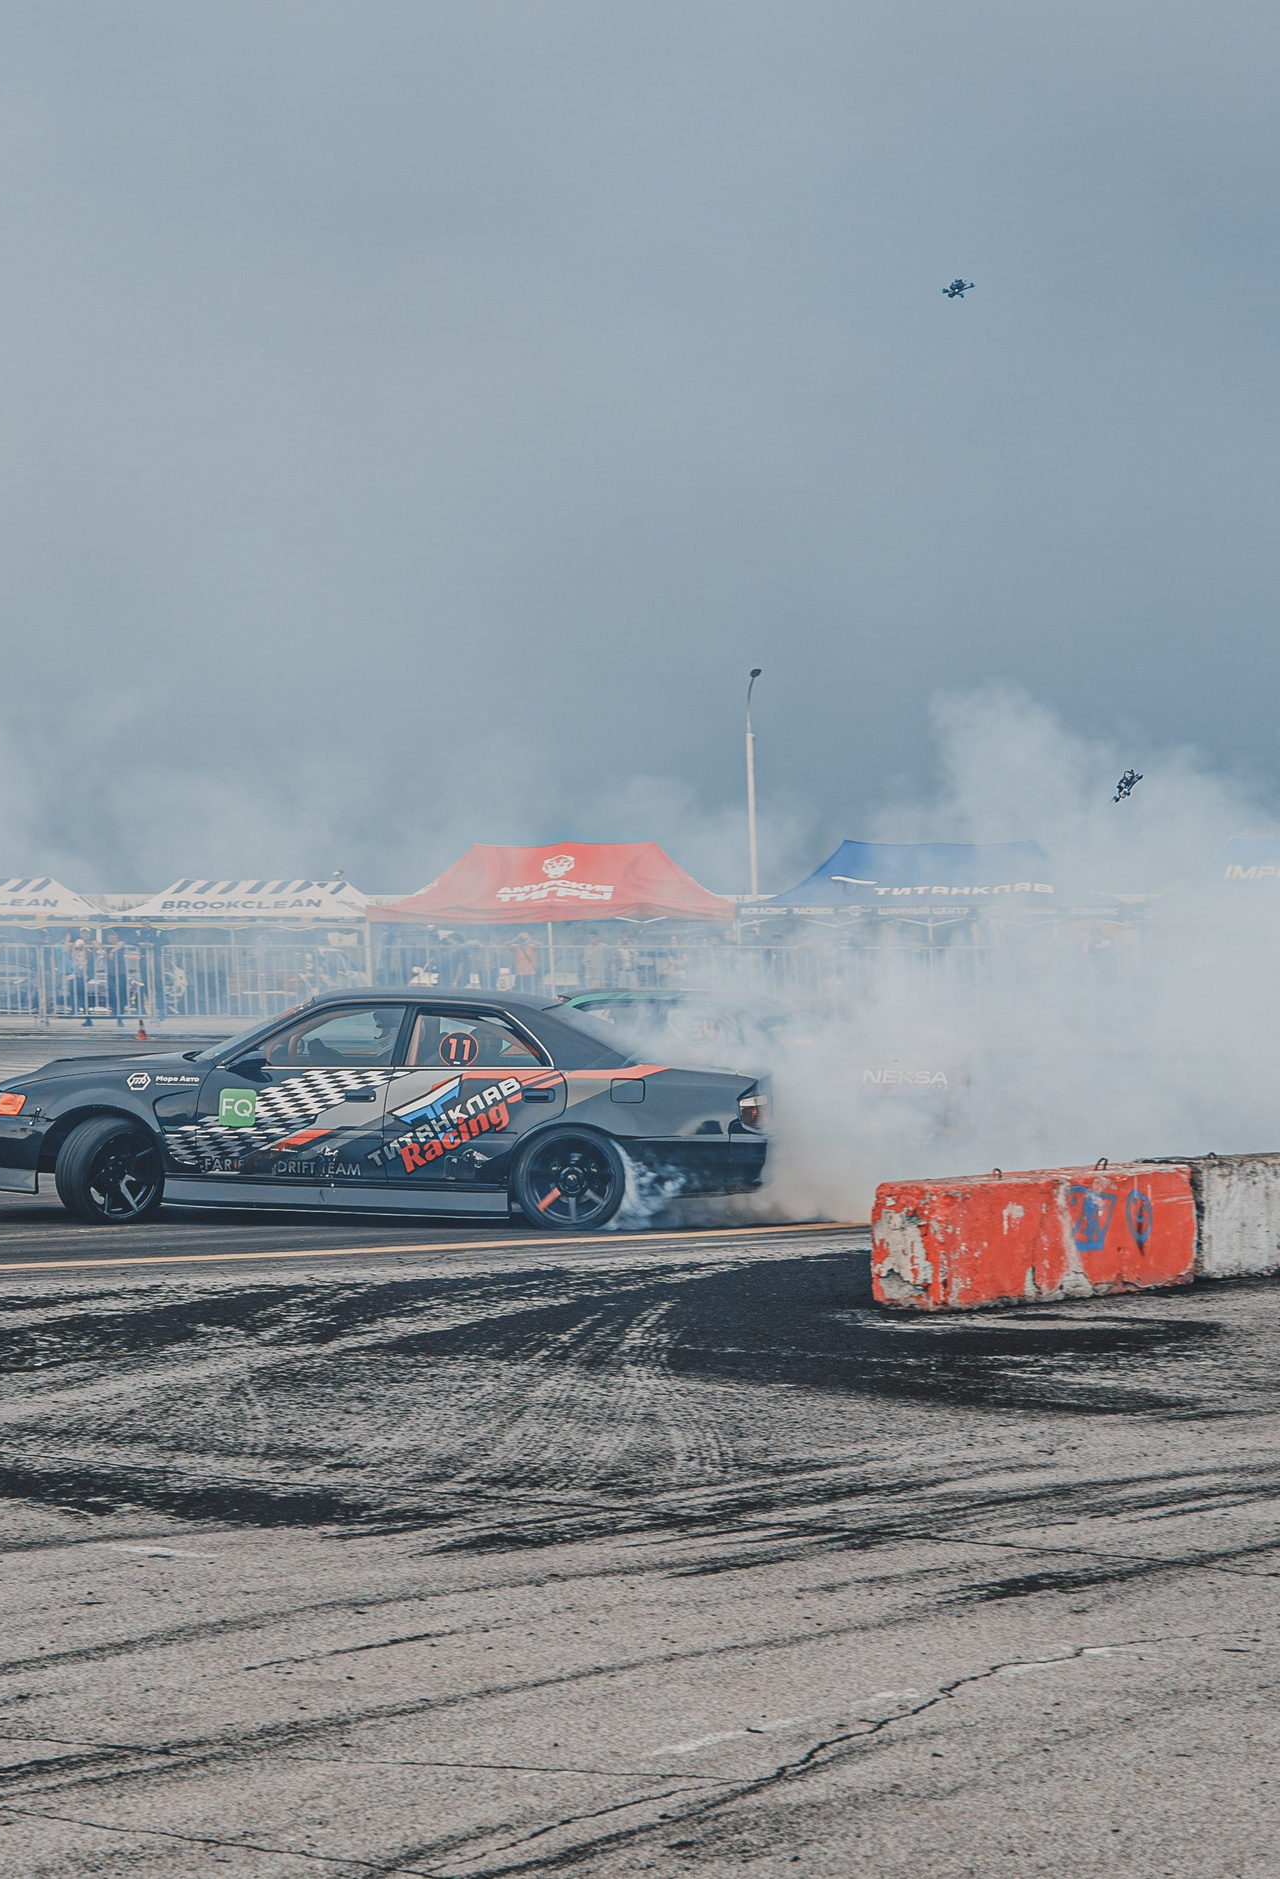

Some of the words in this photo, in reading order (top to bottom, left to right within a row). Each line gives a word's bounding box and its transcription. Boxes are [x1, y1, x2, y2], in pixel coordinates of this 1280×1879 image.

[497, 879, 615, 893] АМУРСКИЕ
[874, 882, 1054, 896] ТИТАНКЛАВ
[496, 887, 613, 902] ТИГРЫ
[161, 898, 323, 910] BROOKCLEAN
[449, 1038, 471, 1061] 11
[155, 1075, 178, 1083] Море
[862, 1069, 948, 1085] NEKSA
[222, 1098, 253, 1117] FQ
[367, 1077, 521, 1166] ТИТАНКЛАВ
[400, 1101, 510, 1173] Racing
[277, 1160, 315, 1175] DRIFT
